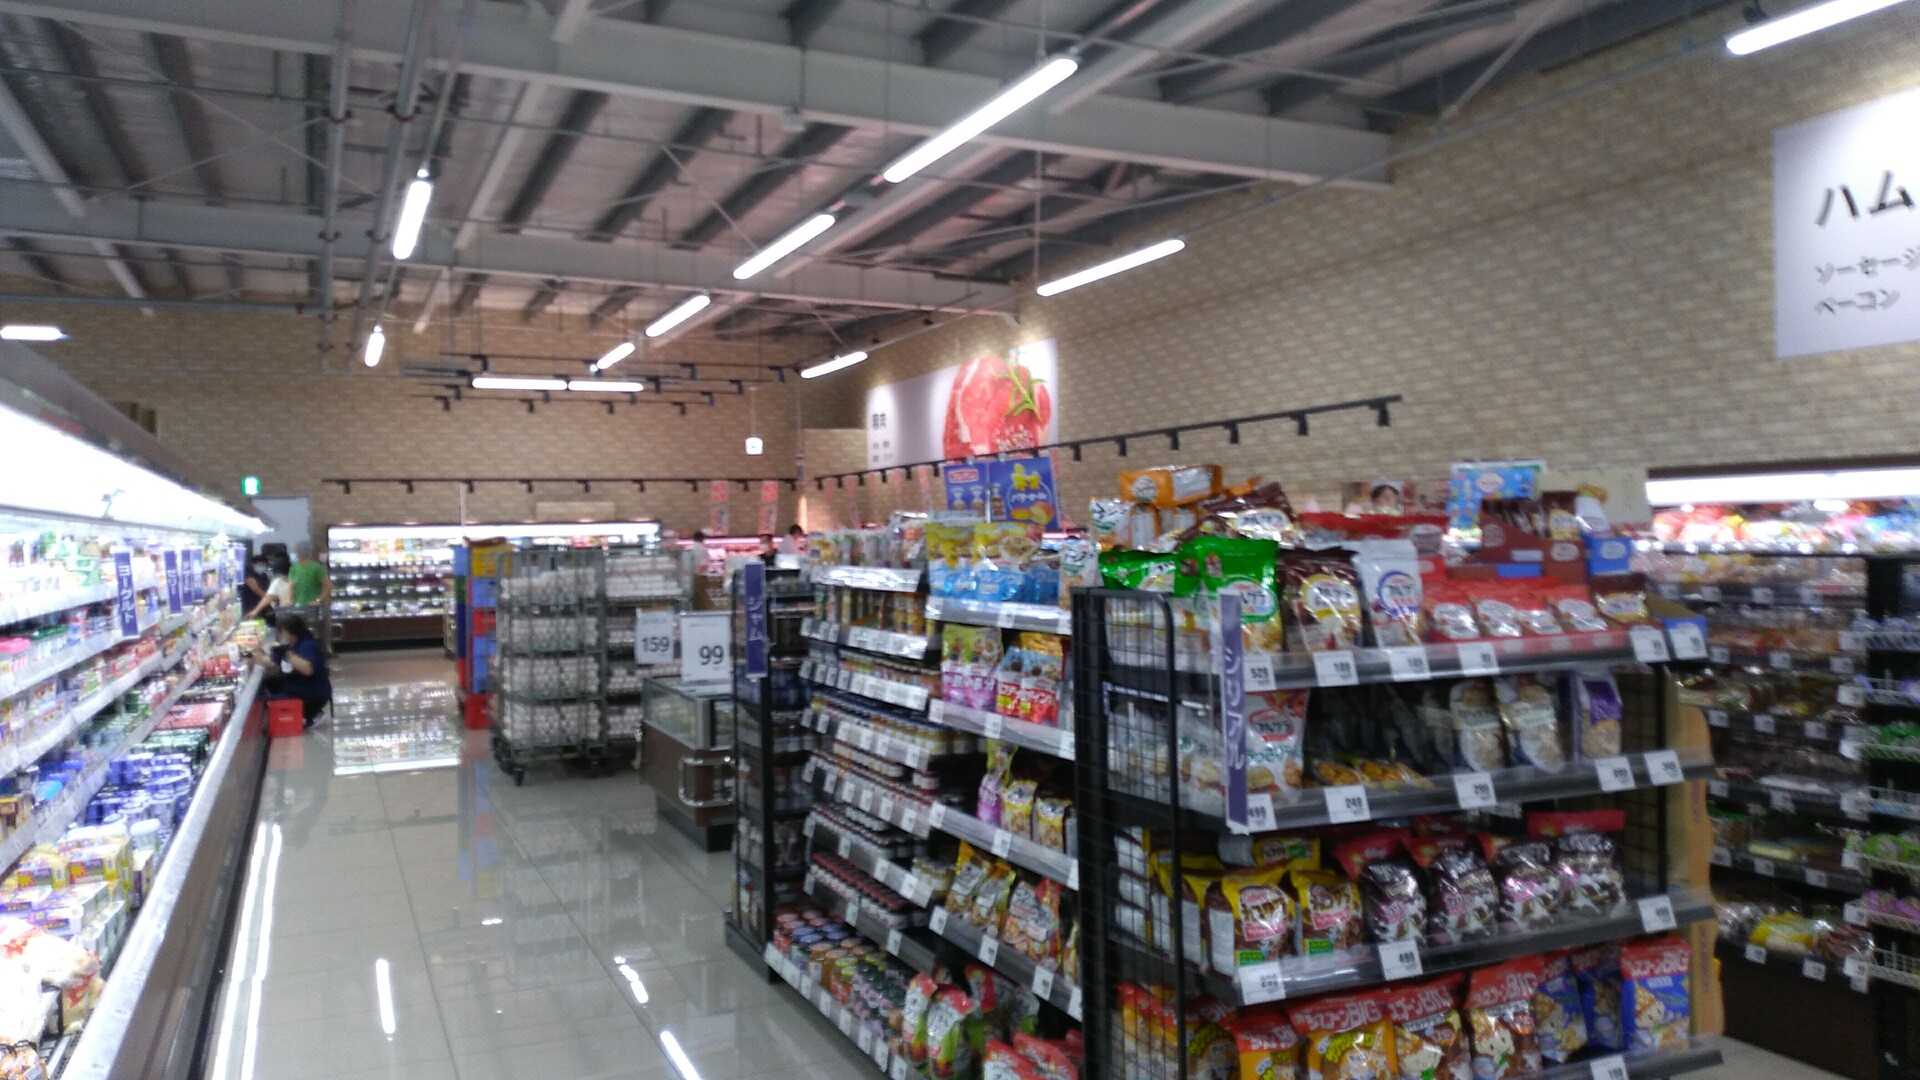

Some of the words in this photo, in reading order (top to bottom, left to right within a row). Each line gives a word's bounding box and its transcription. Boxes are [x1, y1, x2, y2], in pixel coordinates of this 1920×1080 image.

[1815, 169, 1915, 227] ハム
[1814, 288, 1901, 315] ベーコン
[118, 564, 135, 624] ヨーグルト
[642, 637, 670, 653] 159
[699, 644, 724, 665] 99
[1225, 648, 1245, 770] シリアル
